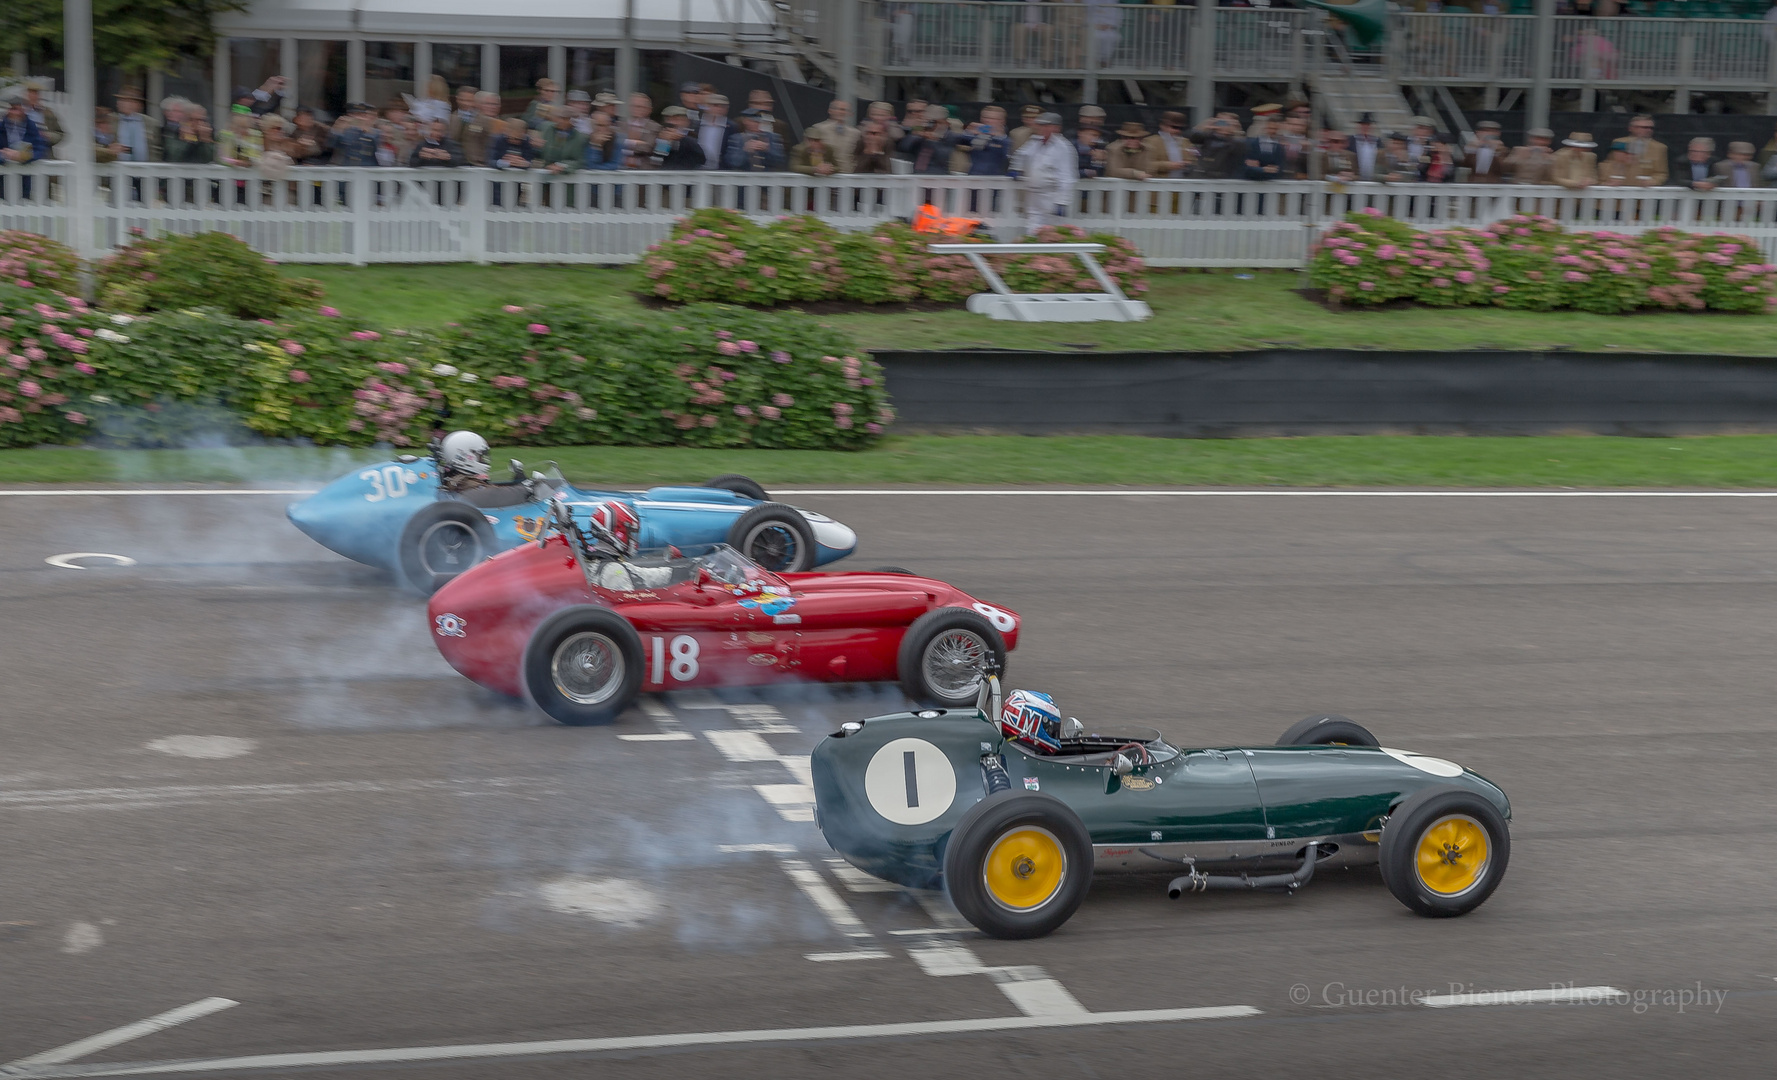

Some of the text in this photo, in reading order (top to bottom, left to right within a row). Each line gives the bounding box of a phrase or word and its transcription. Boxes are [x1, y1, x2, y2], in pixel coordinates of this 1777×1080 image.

[359, 465, 408, 502] 30
[650, 634, 700, 684] 18
[1016, 705, 1042, 737] M
[903, 751, 919, 808] 1
[1270, 840, 1296, 848] DUNLOP
